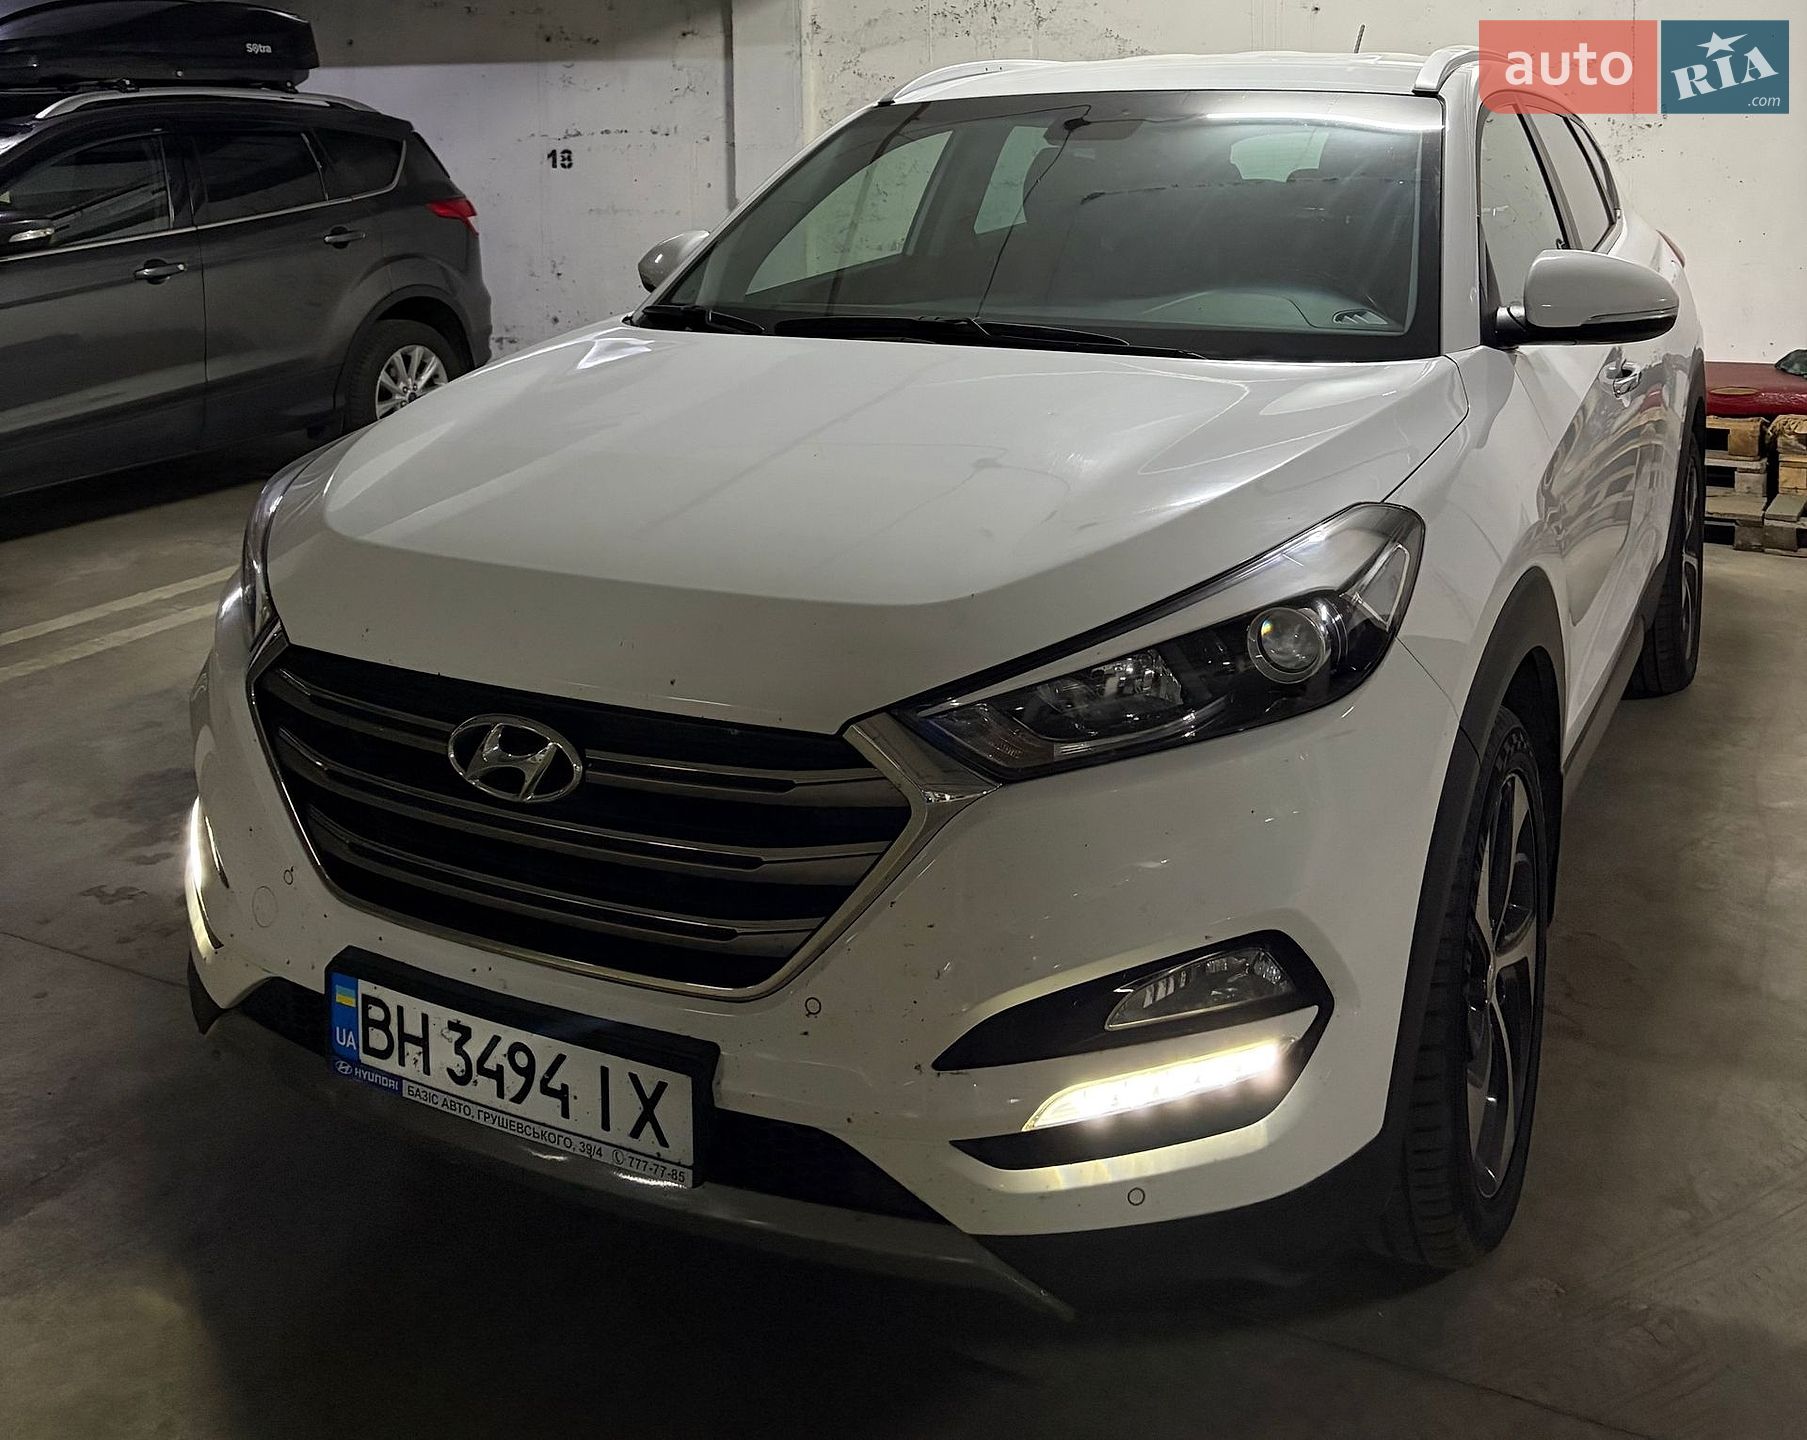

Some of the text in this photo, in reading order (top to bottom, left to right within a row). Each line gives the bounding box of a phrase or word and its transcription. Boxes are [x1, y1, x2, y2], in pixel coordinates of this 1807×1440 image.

[335, 1026, 357, 1050] UA
[354, 1067, 399, 1091] HYUNDAI
[361, 993, 671, 1148] BH 3494 IX
[407, 1085, 439, 1105] БАЗІС
[579, 1141, 603, 1158] 39/4
[627, 1155, 686, 1183] 777-77-85
